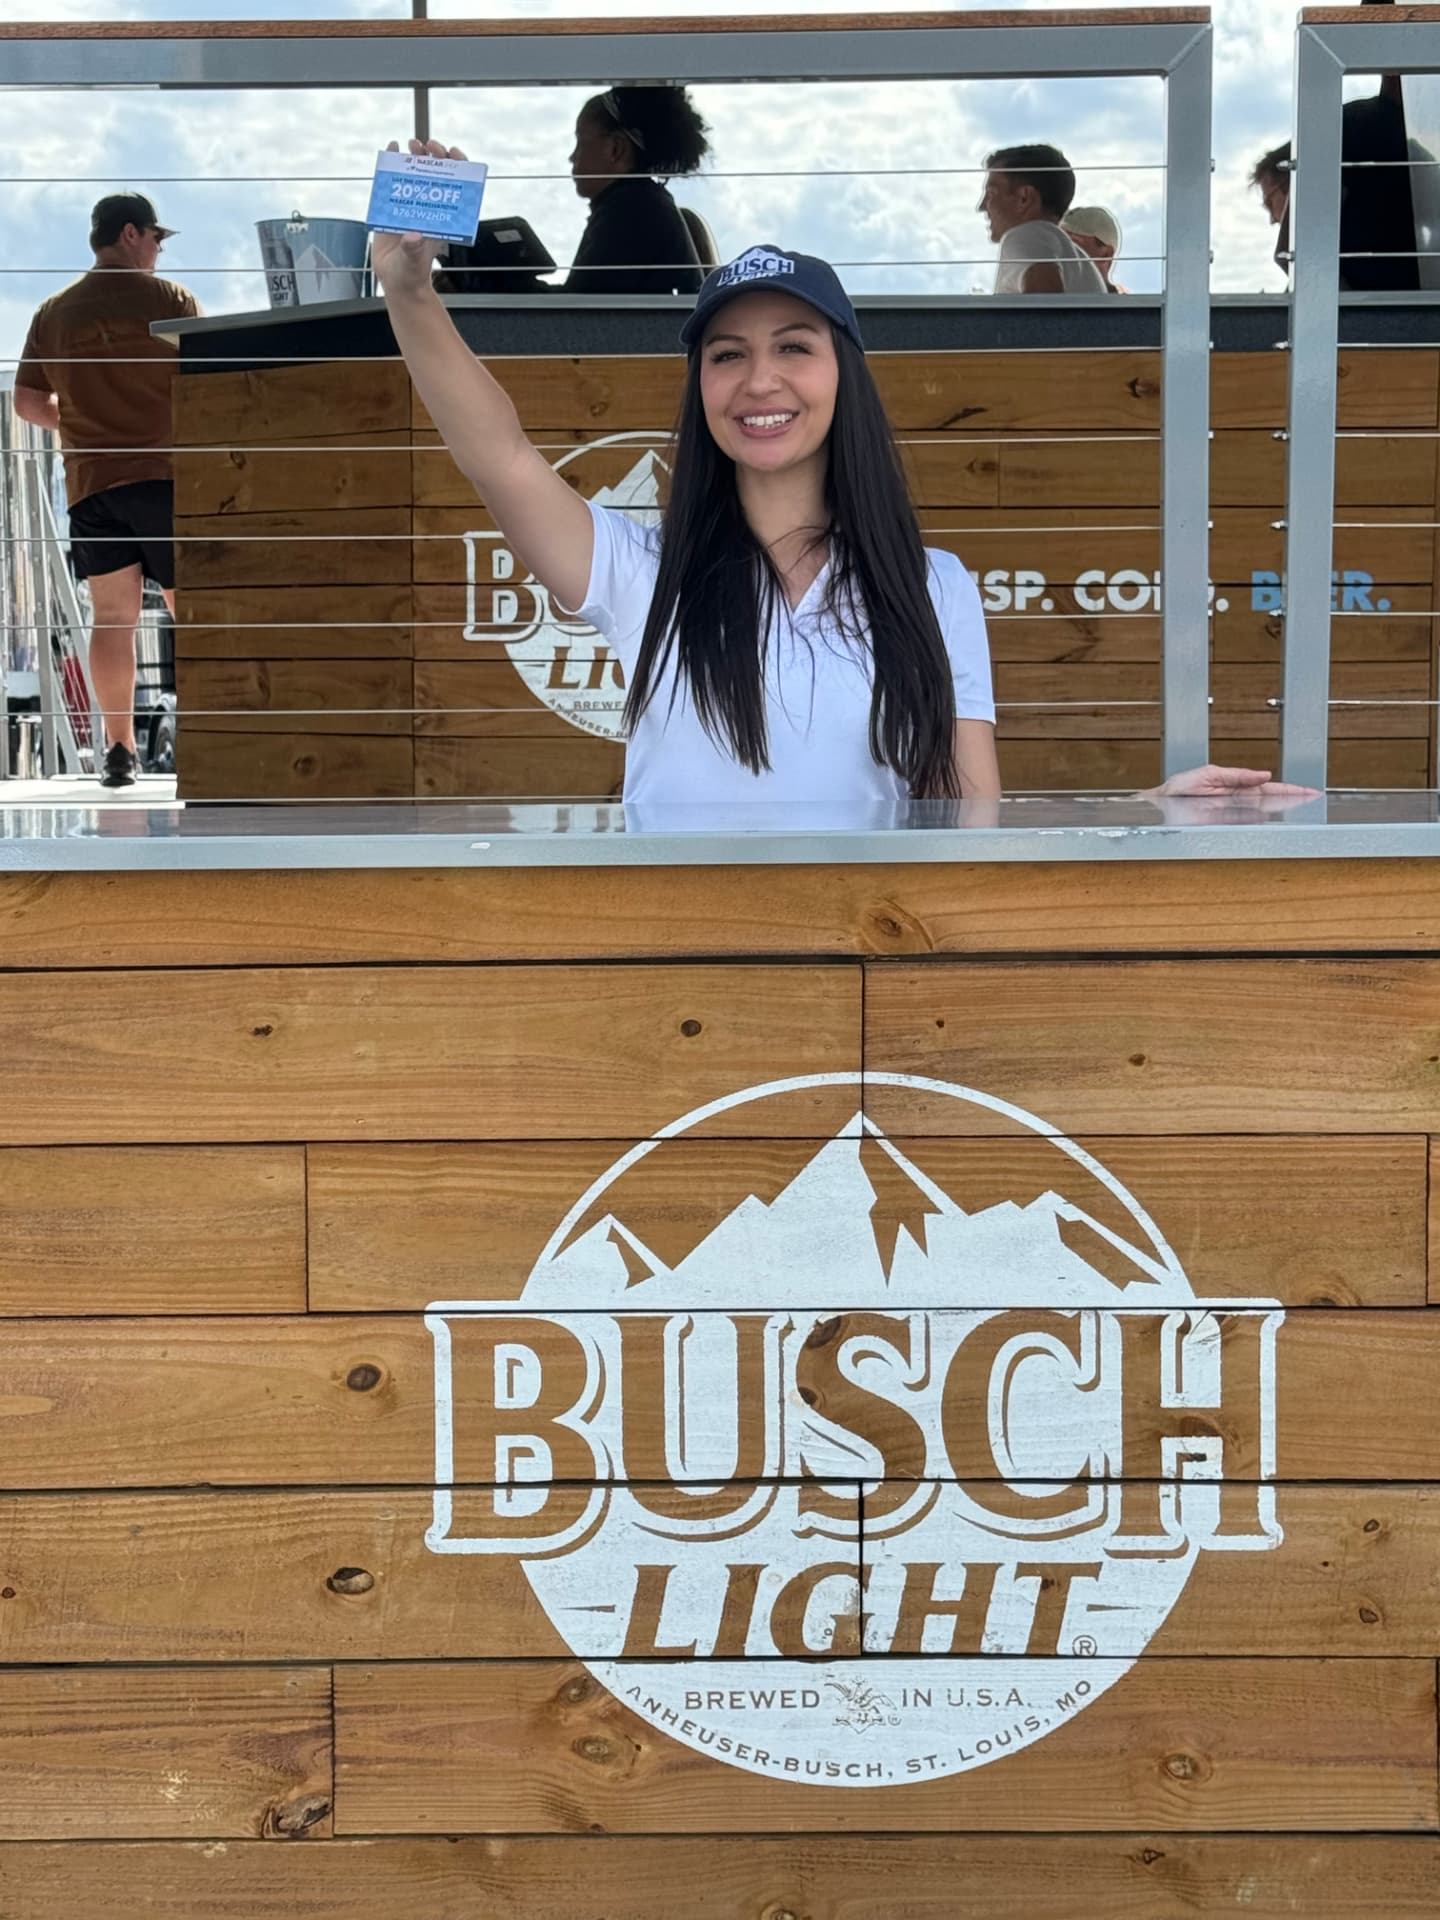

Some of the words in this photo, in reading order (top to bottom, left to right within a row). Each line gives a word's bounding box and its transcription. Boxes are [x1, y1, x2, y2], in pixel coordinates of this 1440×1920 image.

[717, 257, 795, 286] BUSCH
[1074, 569, 1229, 612] CO.
[1251, 570, 1391, 611] BR.
[573, 700, 624, 711] BREWE
[425, 1303, 1284, 1556] BUSCH
[617, 1563, 1103, 1657] LIGHT
[685, 1689, 820, 1710] BREWED
[902, 1687, 932, 1707] IN
[947, 1687, 1032, 1707] U.S.A.
[625, 1685, 894, 1778] ANHEUSER-BUSCH,
[905, 1754, 947, 1774] ST.
[957, 1714, 1051, 1762] LOUIS,
[1055, 1680, 1092, 1712] MO
